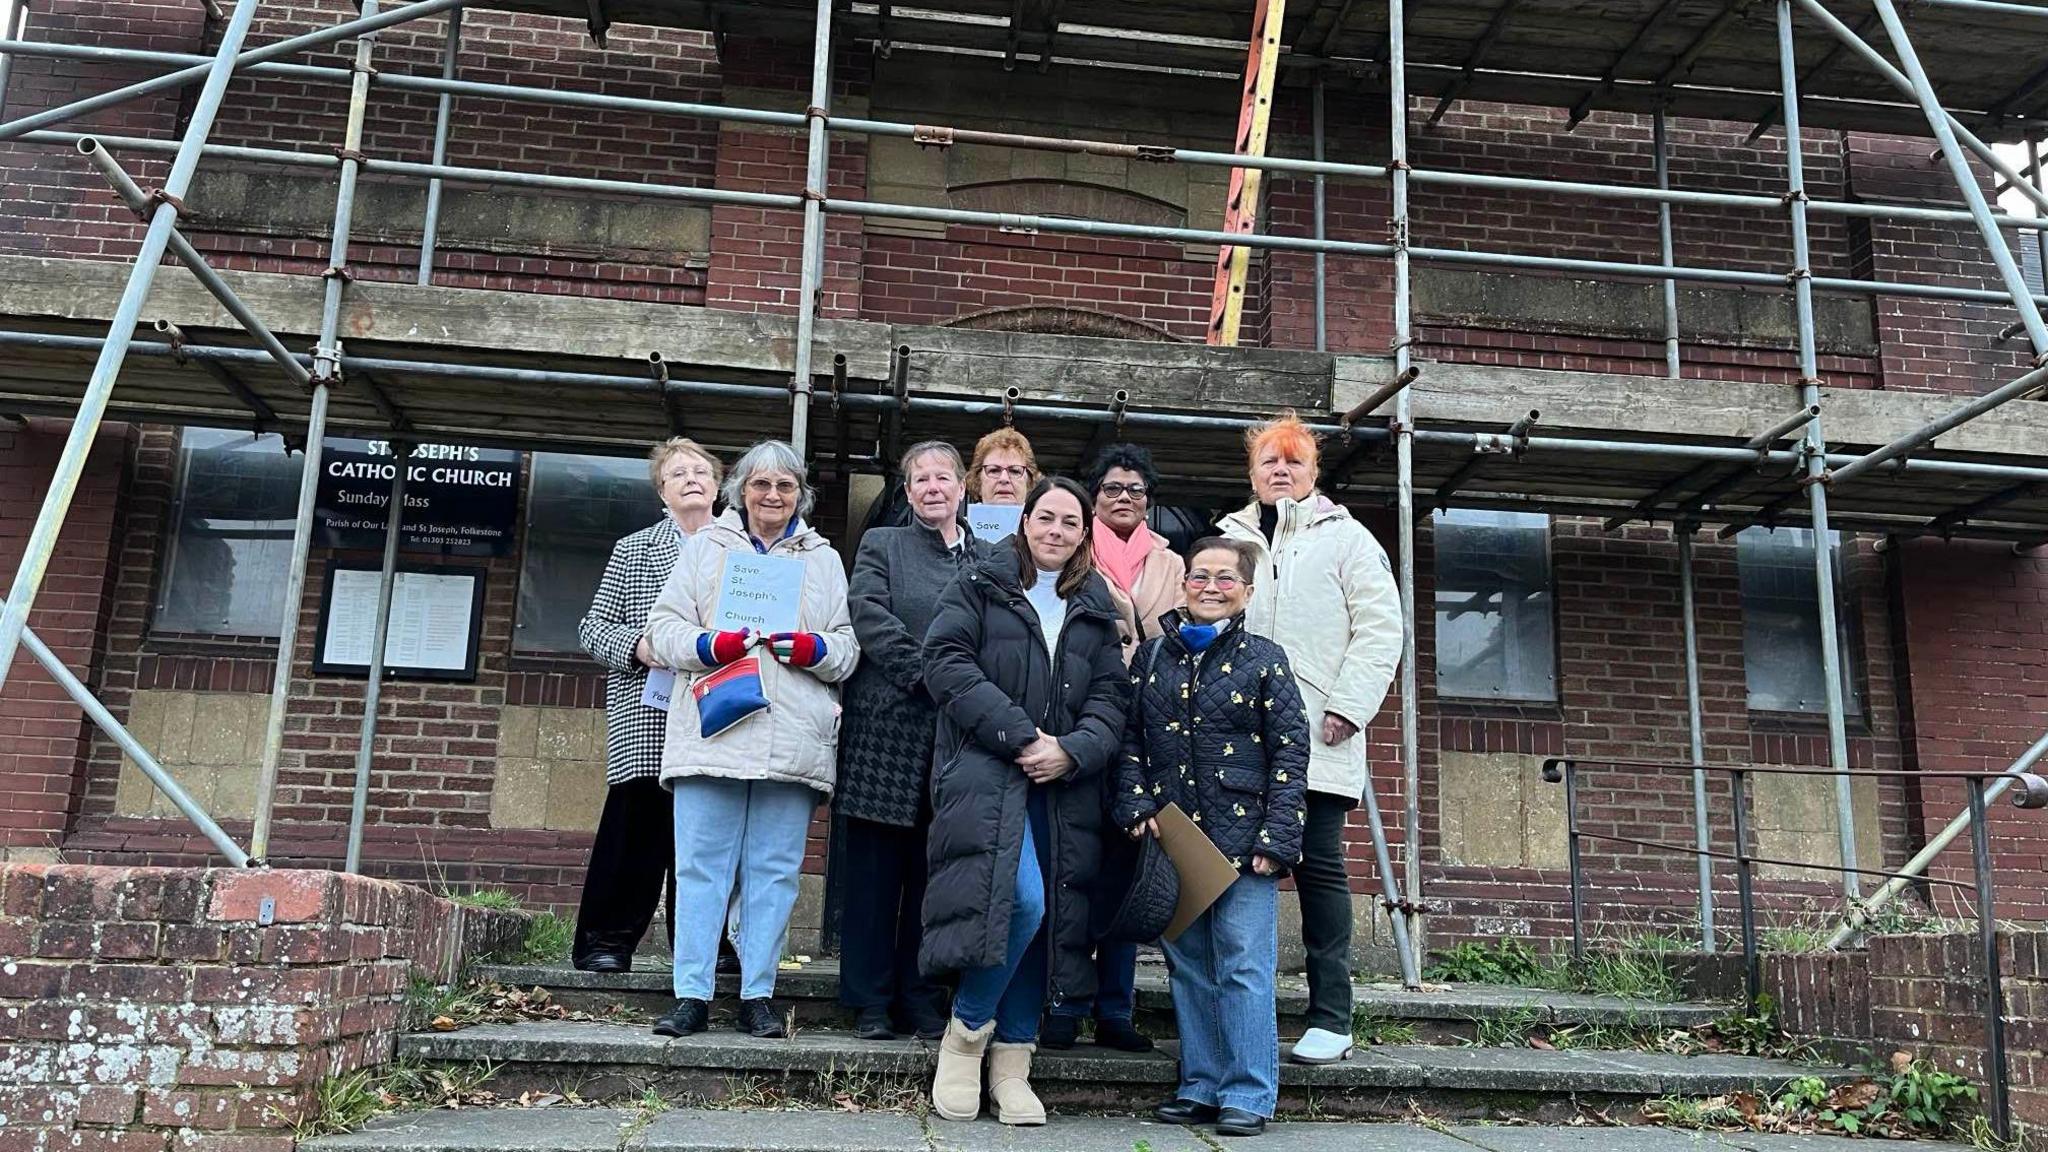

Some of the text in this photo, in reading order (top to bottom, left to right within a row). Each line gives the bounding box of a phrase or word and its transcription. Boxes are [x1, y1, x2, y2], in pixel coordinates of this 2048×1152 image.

[367, 440, 389, 456] ST
[328, 461, 512, 488] CATHOIC CHURCH
[337, 489, 430, 508] Sunday ass
[326, 518, 350, 528] Parish
[351, 520, 361, 528] of
[363, 520, 379, 529] Our
[402, 523, 416, 531] and
[418, 523, 427, 532] St
[460, 526, 502, 537] Folkestone
[976, 521, 1000, 530] Save
[733, 564, 760, 575] Save
[728, 588, 777, 601] Joseph's
[725, 611, 765, 624] Church
